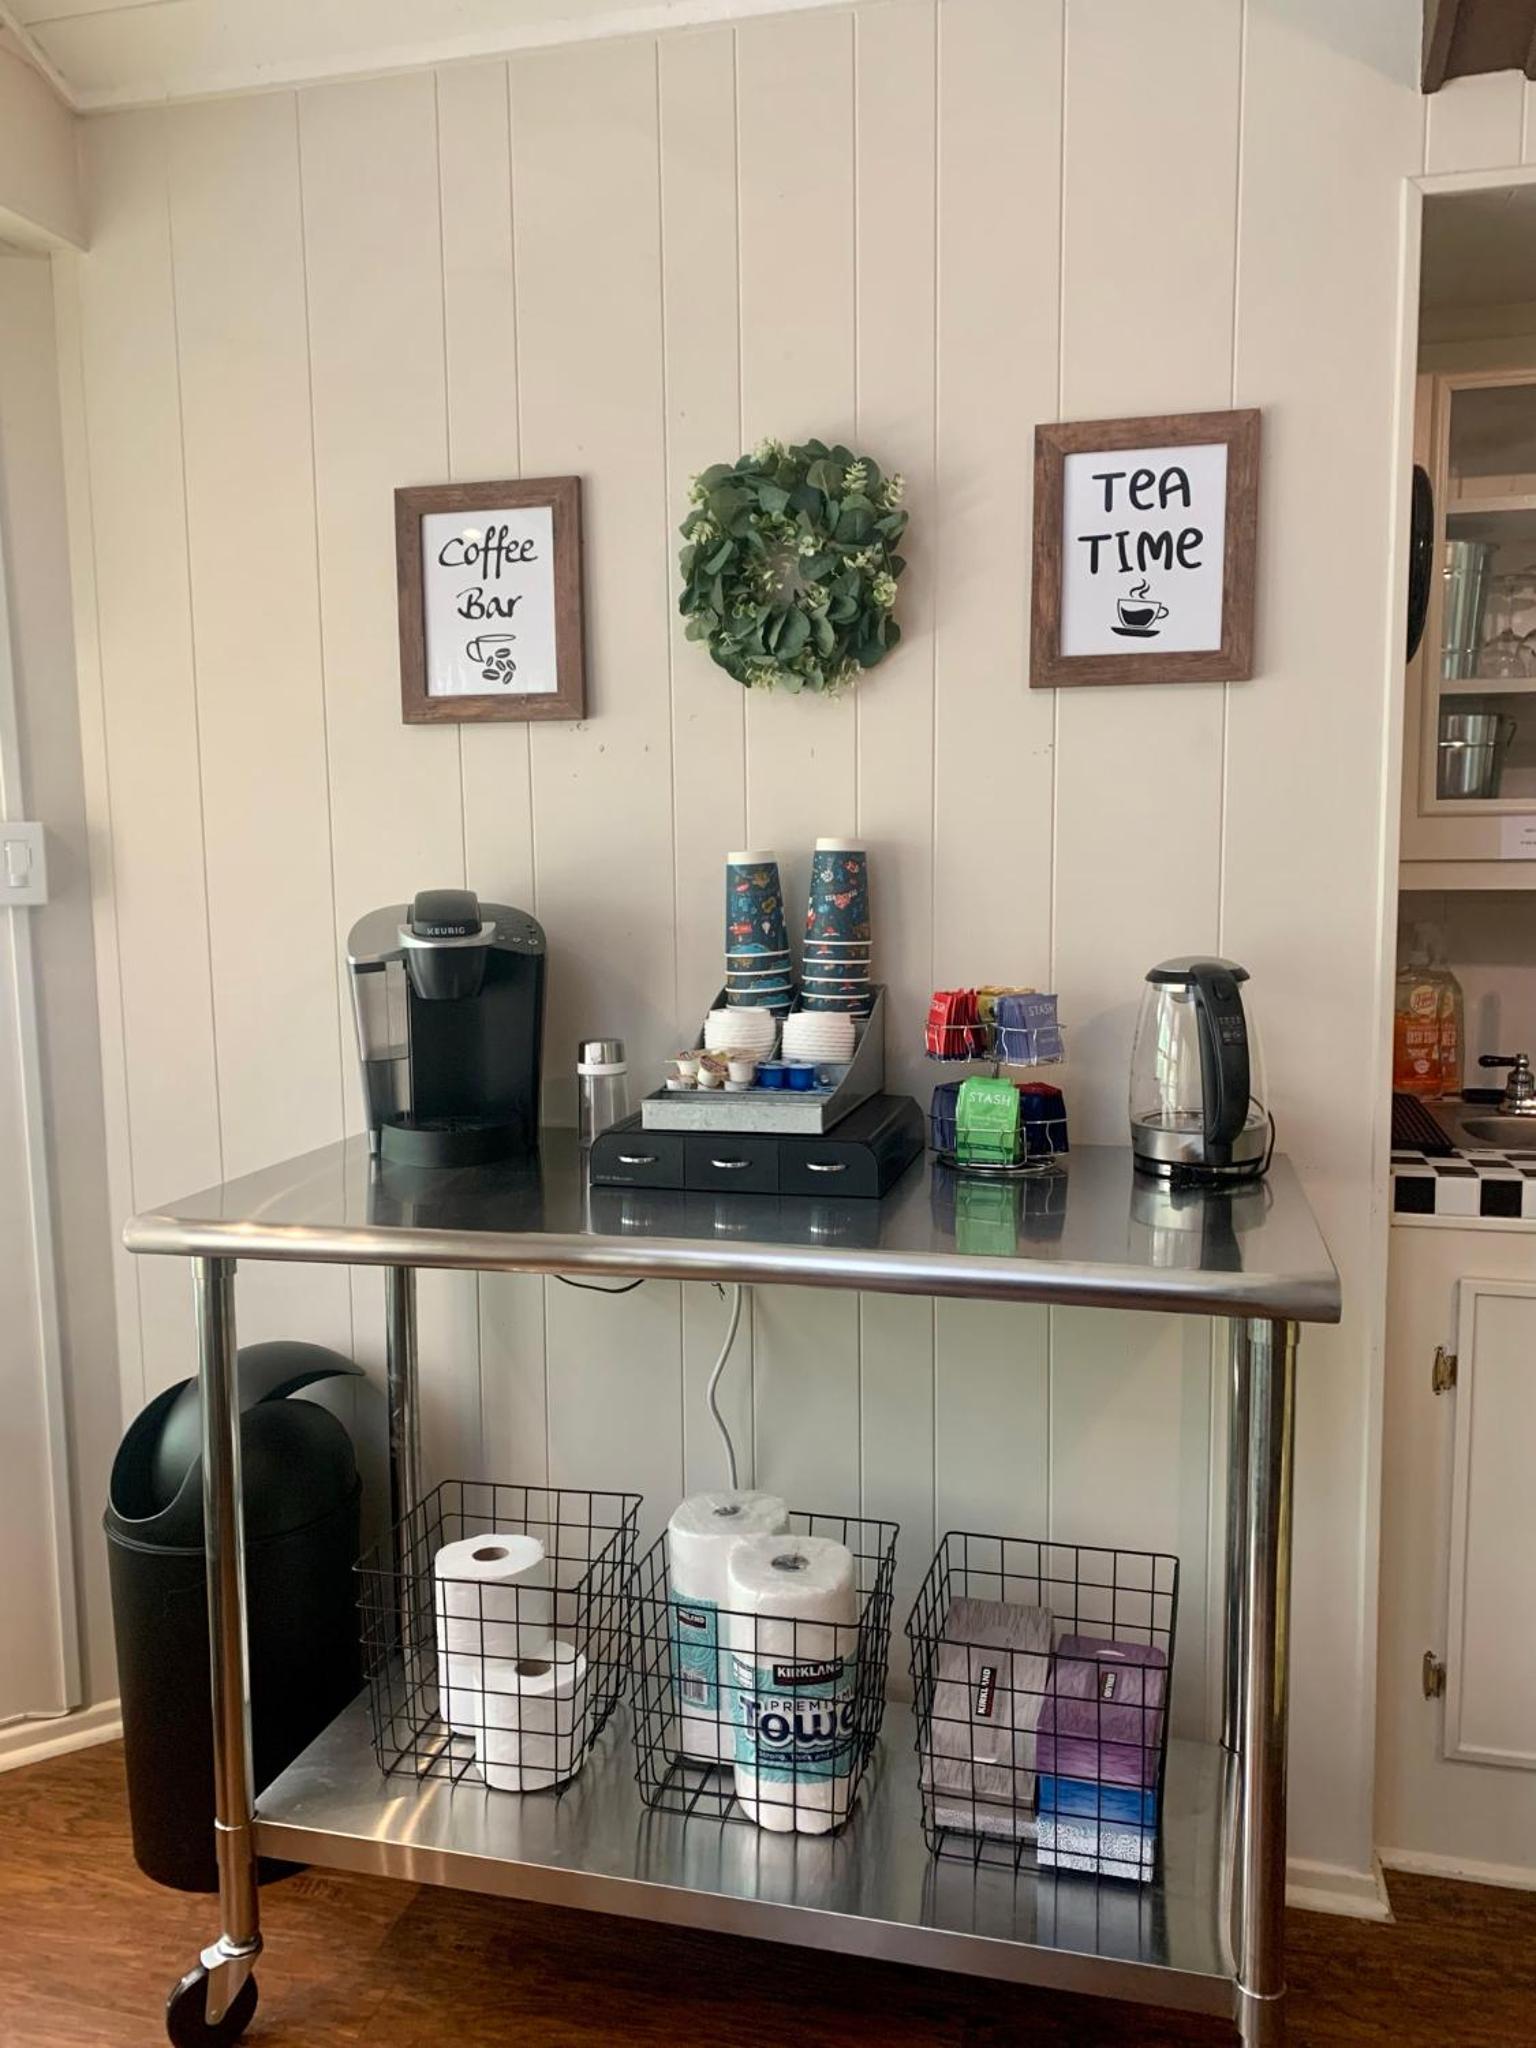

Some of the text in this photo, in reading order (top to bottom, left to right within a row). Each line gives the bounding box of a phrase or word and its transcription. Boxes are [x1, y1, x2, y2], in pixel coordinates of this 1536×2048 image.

[438, 524, 539, 580] Coffee
[456, 586, 523, 620] Bar
[426, 926, 466, 936] KEURIG
[969, 1091, 1011, 1108] STASH
